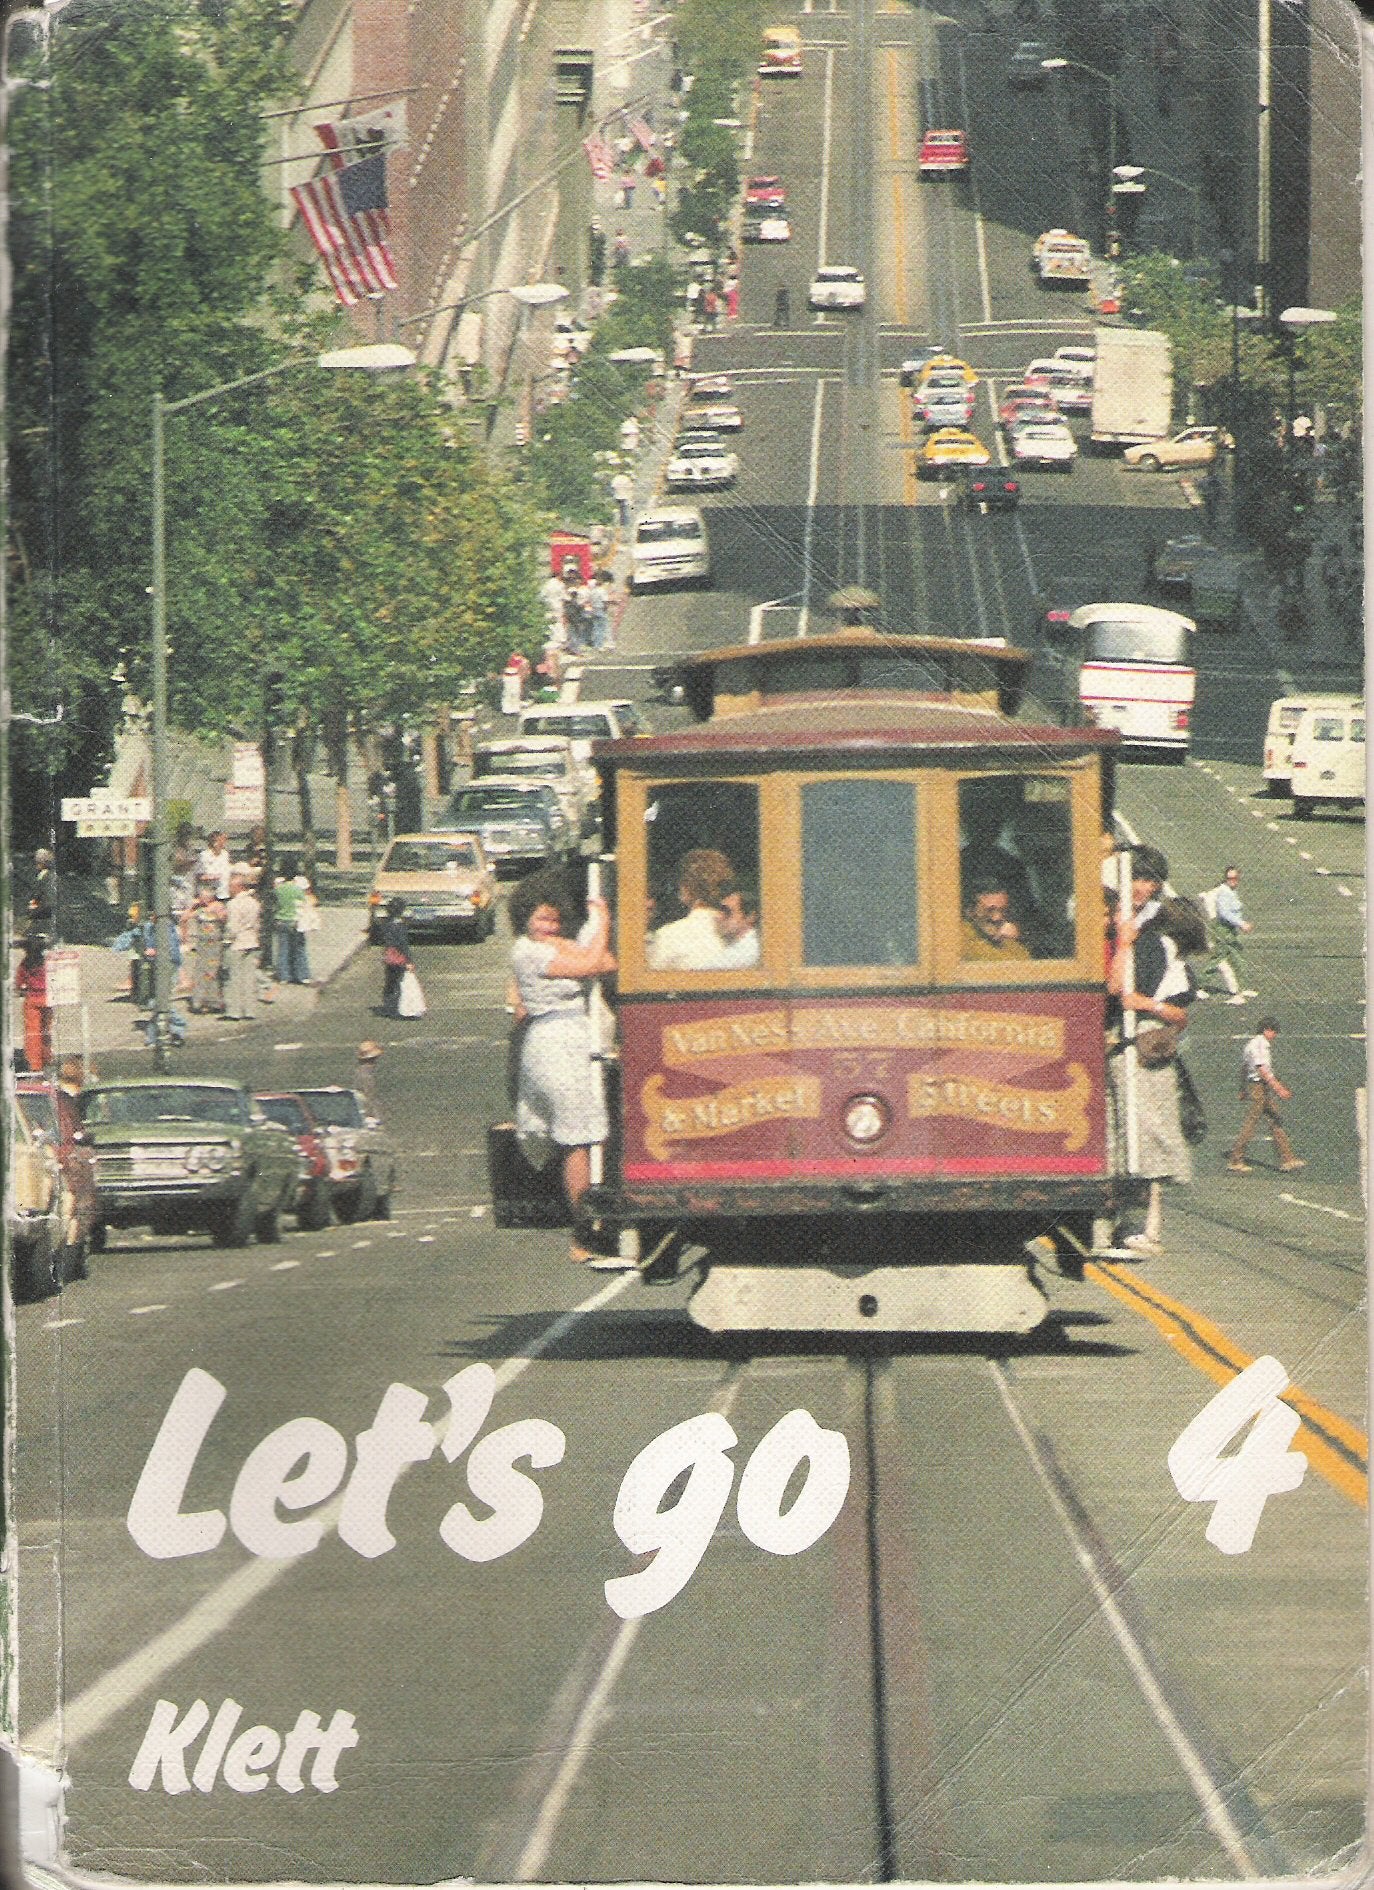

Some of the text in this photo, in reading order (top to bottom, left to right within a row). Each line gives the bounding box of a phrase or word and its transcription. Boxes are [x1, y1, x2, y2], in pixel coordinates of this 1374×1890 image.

[70, 802, 142, 816] GRANT
[670, 1029, 726, 1054] Van
[731, 1018, 803, 1048] Ness
[897, 1012, 1060, 1047] California
[661, 1085, 806, 1133] & Market
[919, 1076, 1058, 1125] Streets
